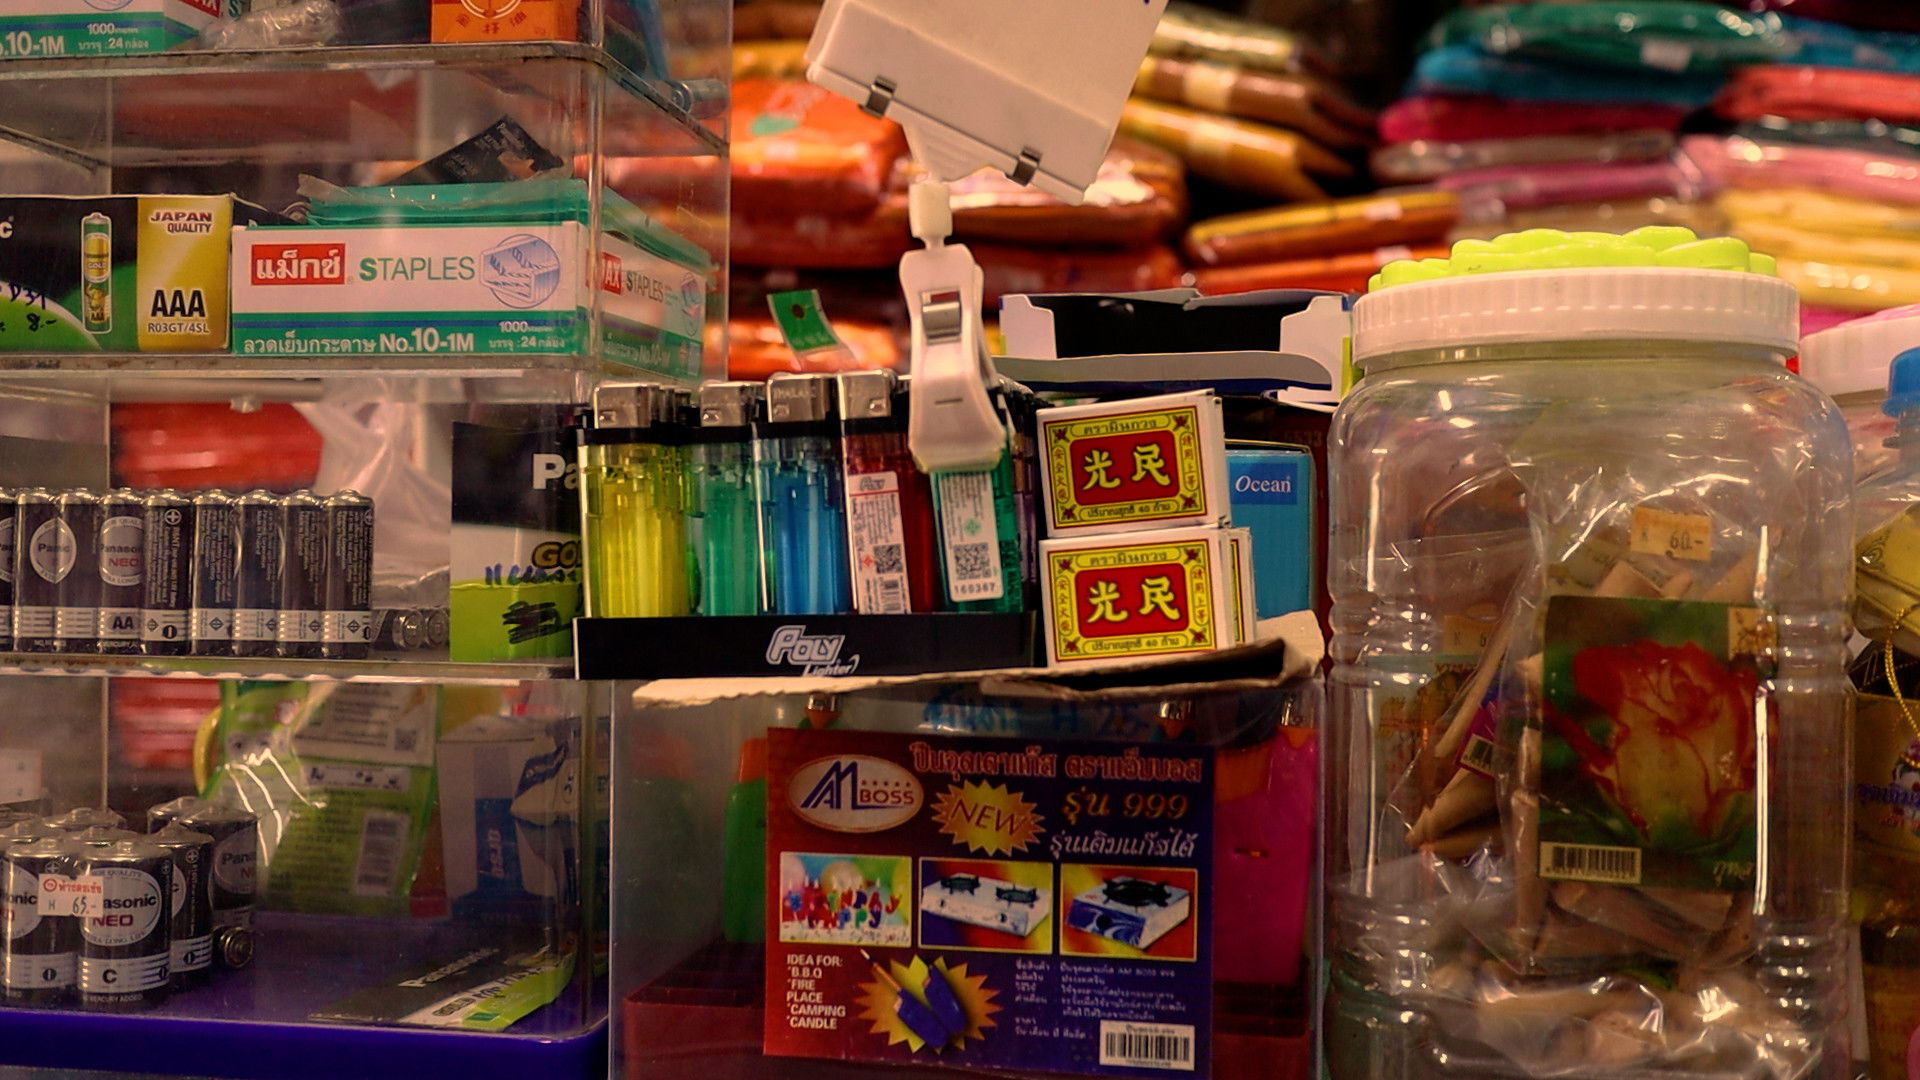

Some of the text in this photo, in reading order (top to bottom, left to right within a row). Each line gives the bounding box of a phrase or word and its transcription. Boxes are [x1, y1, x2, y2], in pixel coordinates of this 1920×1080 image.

[87, 23, 115, 34] 1000
[150, 211, 213, 222] JAPAN
[167, 222, 212, 234] QUALITY
[256, 249, 341, 281] แม็กซ์
[359, 257, 476, 281] STAPLES
[603, 257, 621, 290] AX
[626, 270, 664, 303] STAPLES
[151, 290, 206, 317] AAA
[499, 321, 528, 333] 1000
[244, 328, 474, 354] ลวดเย็บกระดาษ No.10-1M
[1235, 475, 1292, 493] Ocean
[109, 558, 140, 567] NEO
[112, 615, 134, 630] AA
[801, 654, 861, 676] Lighter
[909, 741, 1058, 782] ปืนจุดเตาแก๊ส
[860, 789, 914, 804] BOSS
[1061, 785, 1189, 825] รุ่น 999
[950, 799, 1027, 836] NEW
[1050, 825, 1200, 859] รุ่นเติมแก๊สได้
[104, 894, 157, 909] asonic
[93, 915, 133, 927] NEO
[787, 953, 843, 967] IDEA FOR:
[102, 969, 118, 983] C
[786, 991, 823, 1004] PLACE
